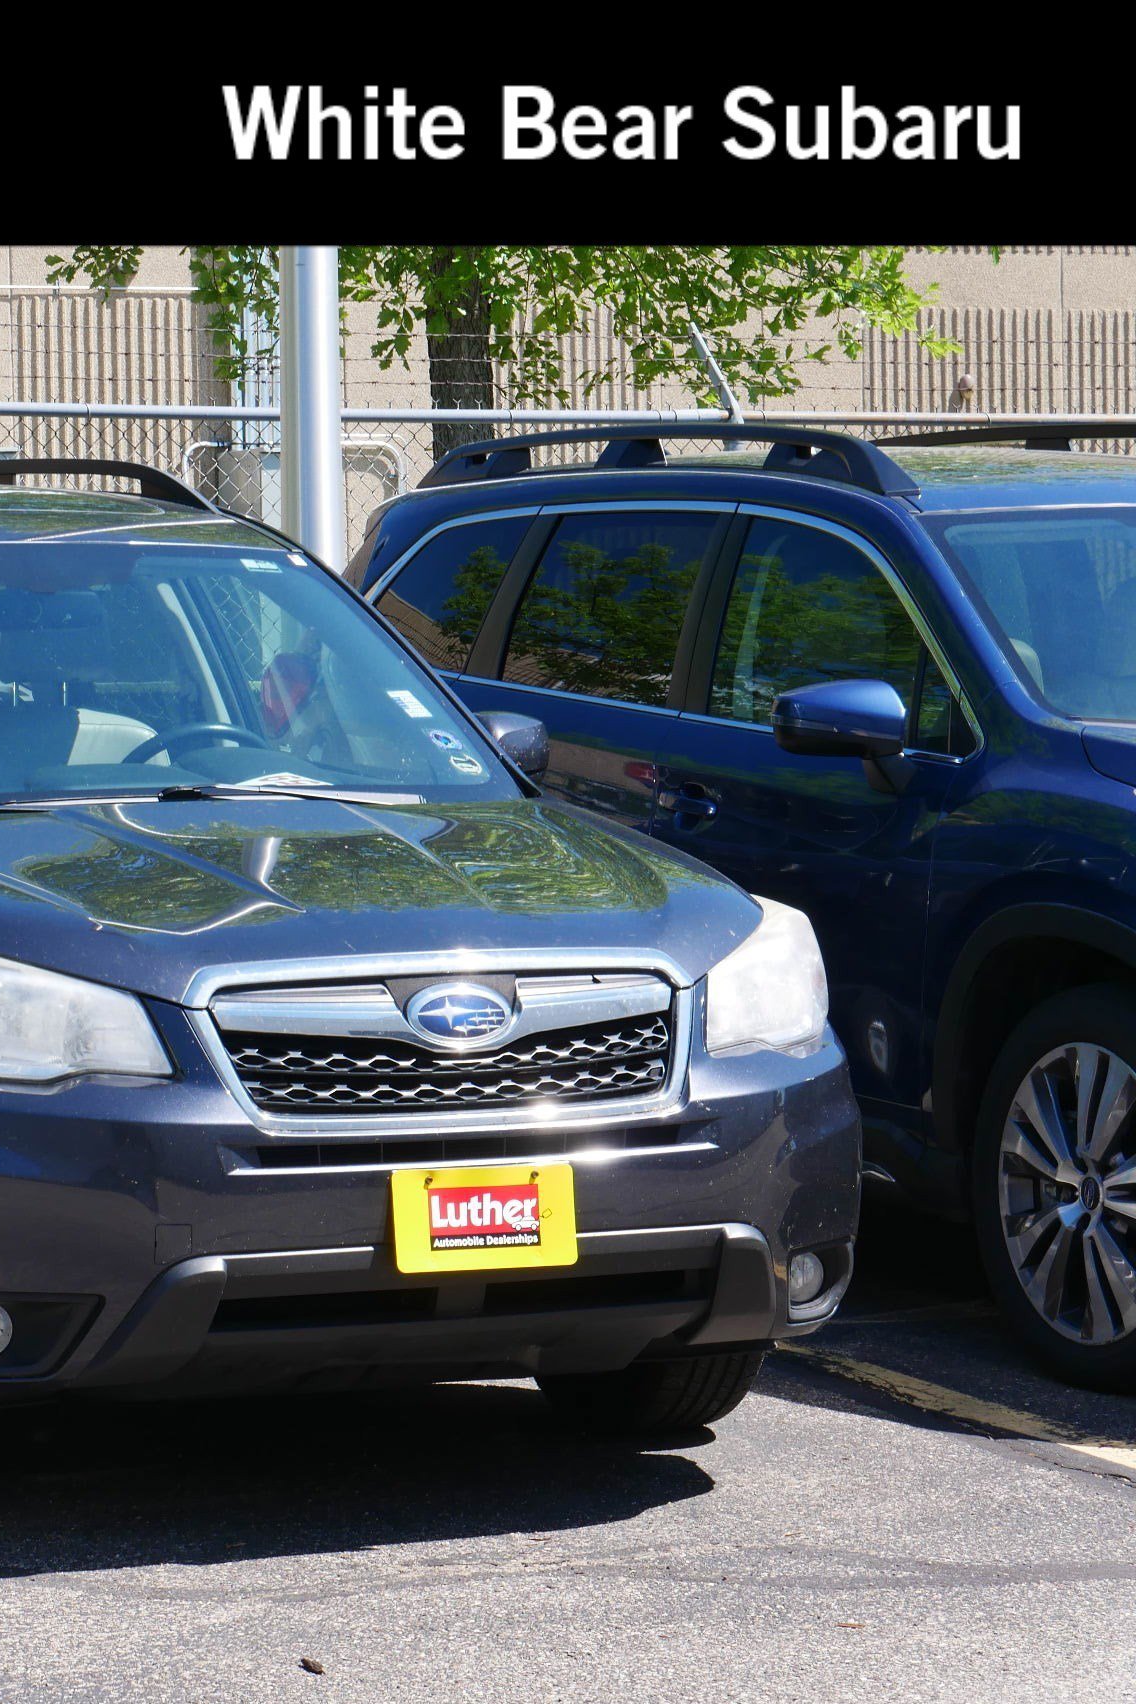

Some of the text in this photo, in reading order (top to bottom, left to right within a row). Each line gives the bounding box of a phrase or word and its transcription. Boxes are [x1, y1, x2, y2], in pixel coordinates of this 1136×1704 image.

[430, 1192, 537, 1228] Luther
[433, 1233, 538, 1248] Automobile Dealerships
